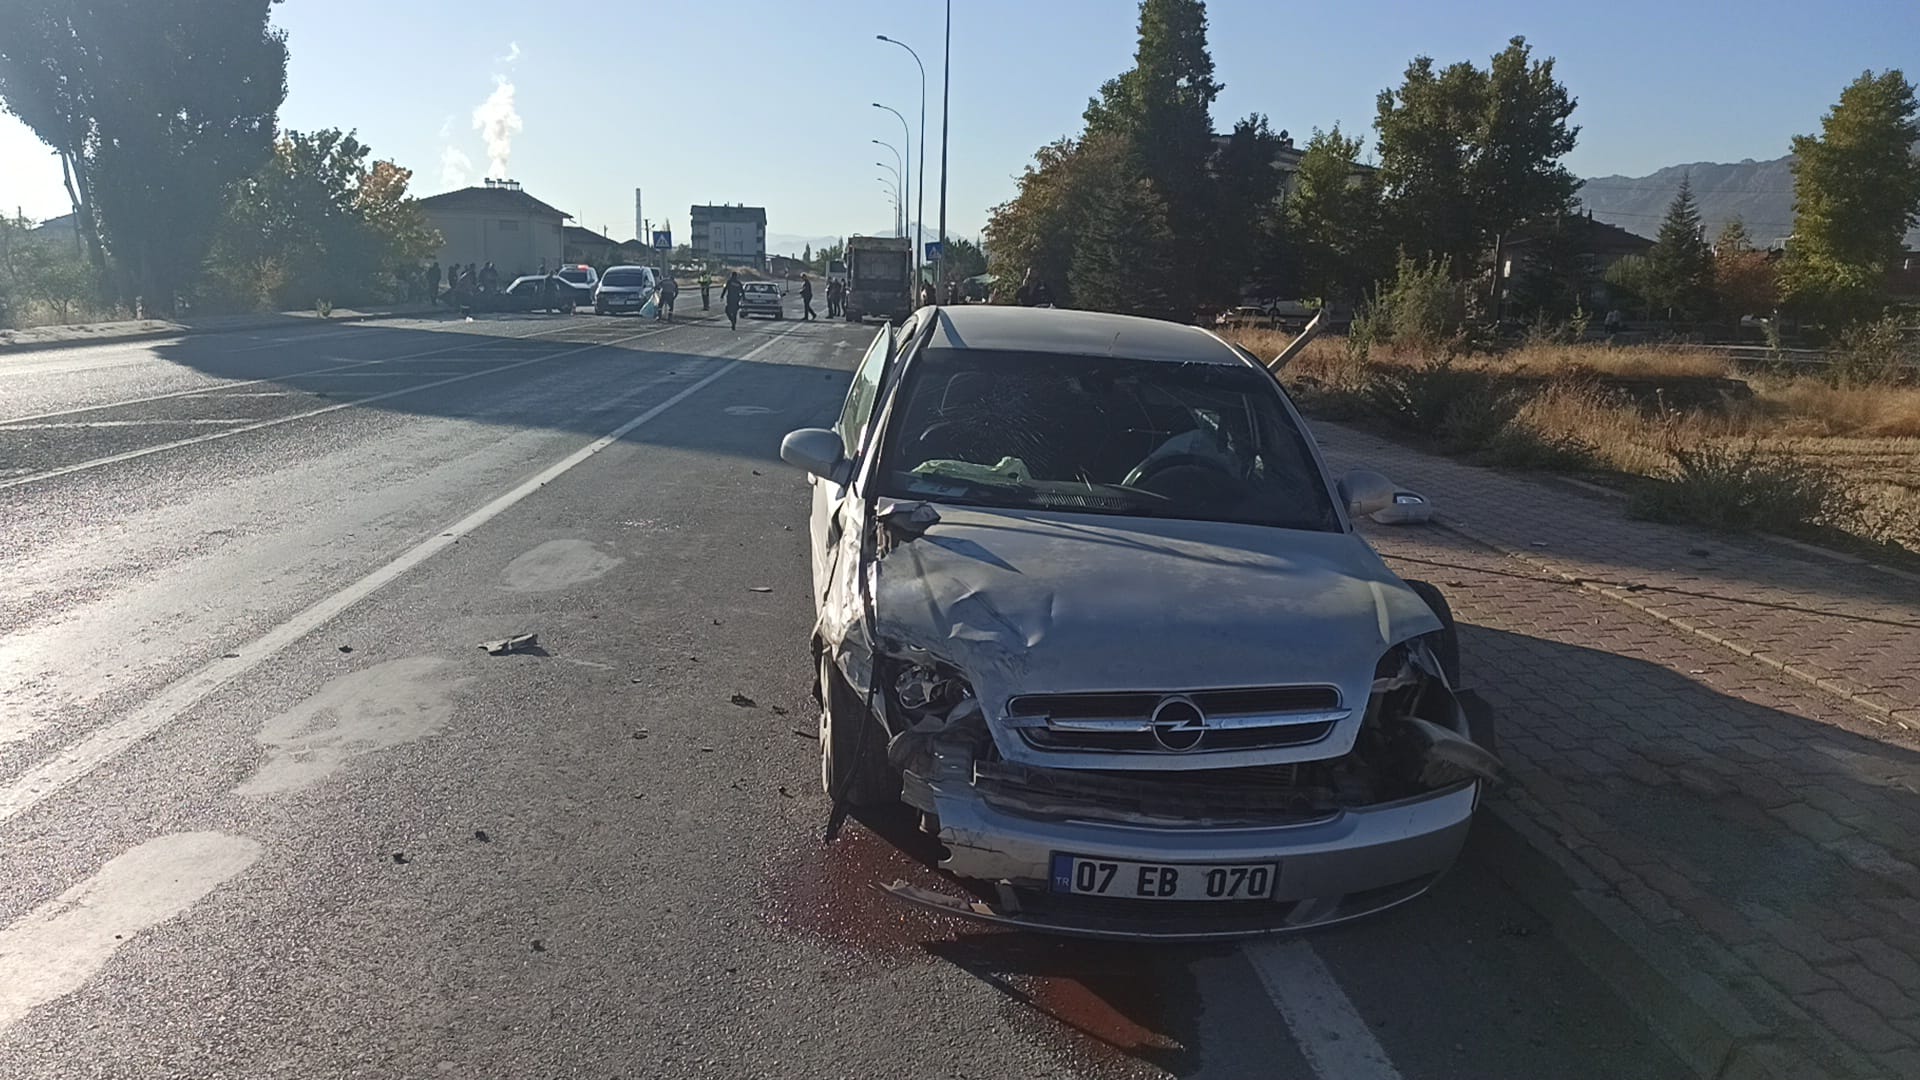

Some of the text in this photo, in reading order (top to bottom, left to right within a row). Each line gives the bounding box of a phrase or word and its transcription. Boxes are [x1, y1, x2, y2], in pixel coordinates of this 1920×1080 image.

[1055, 861, 1268, 898] TR 07 EB 070
